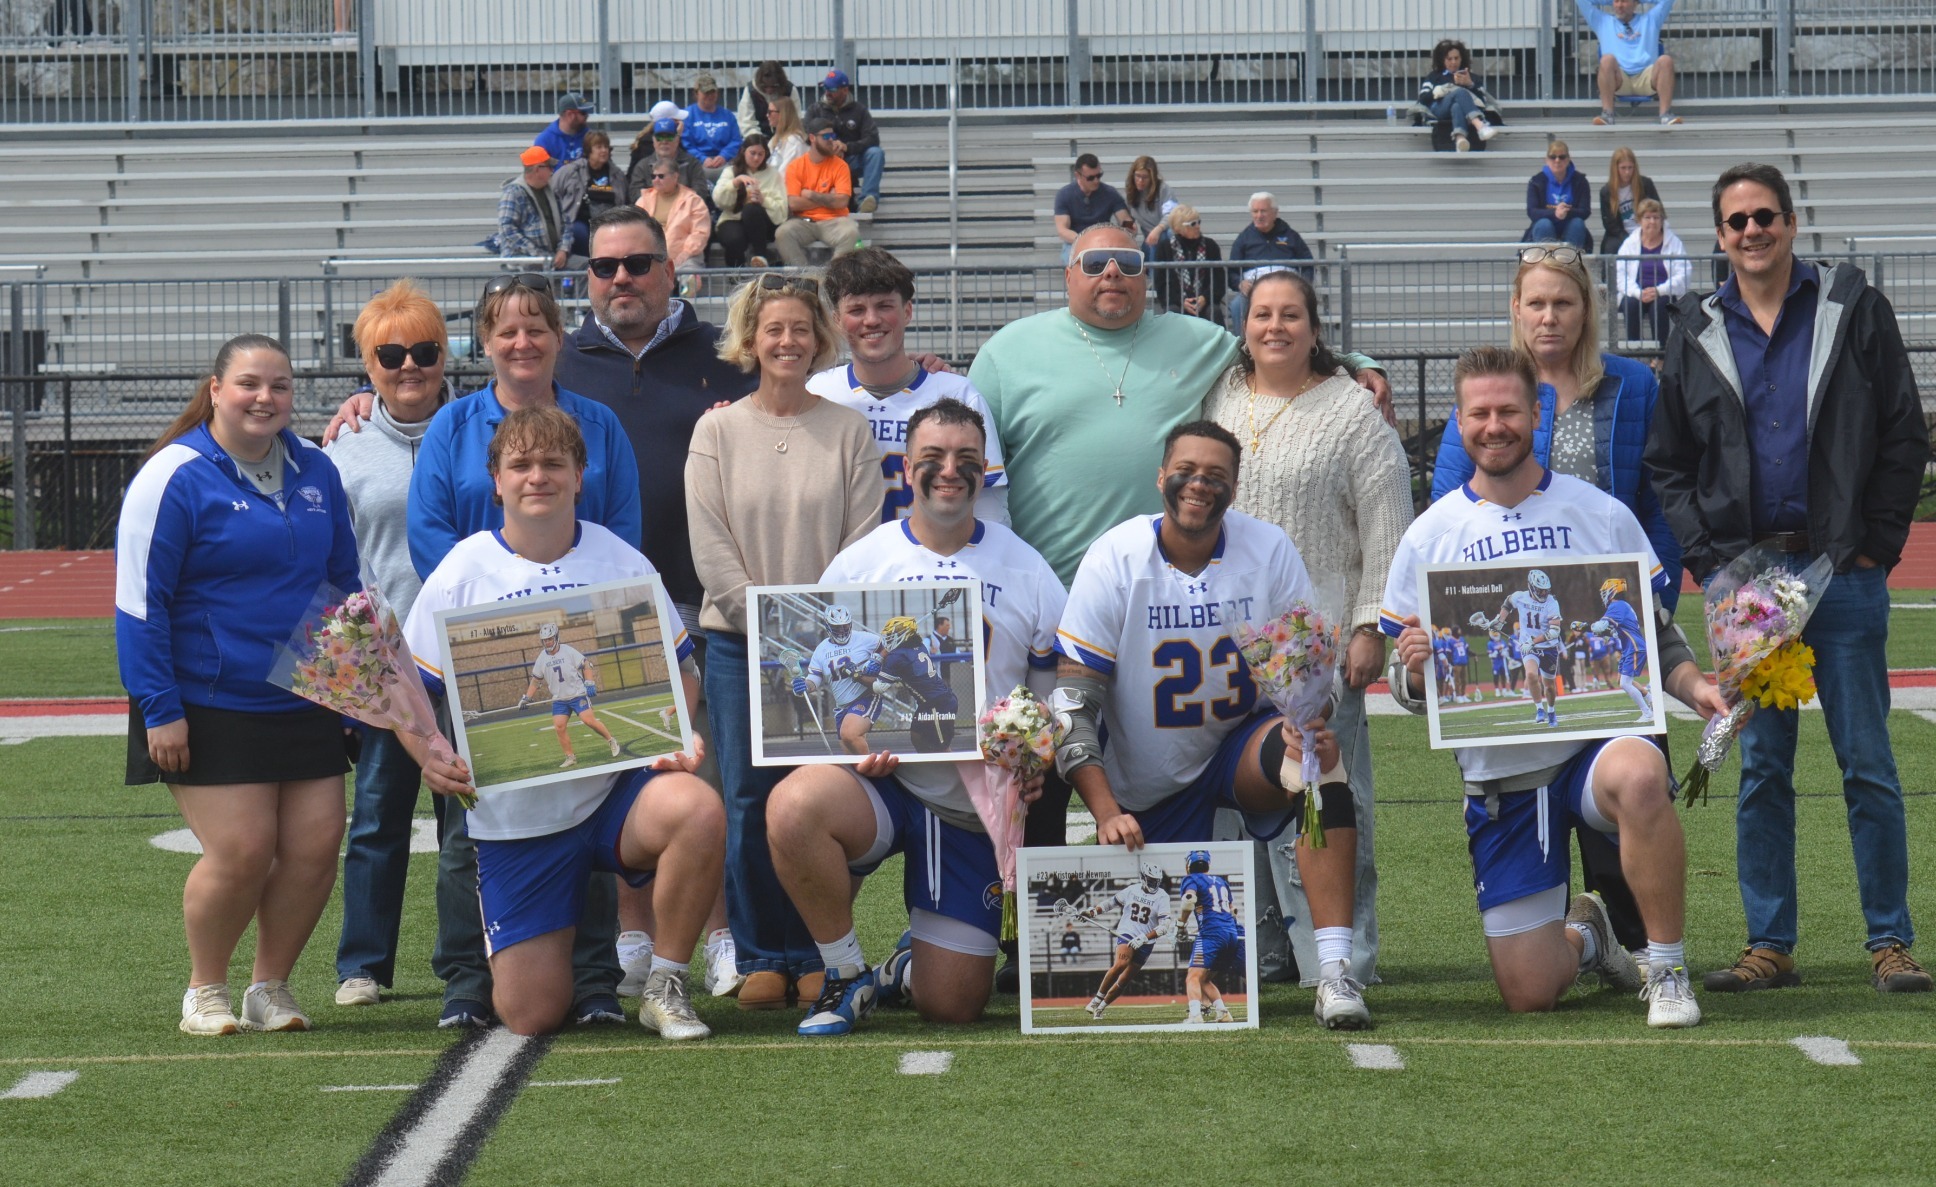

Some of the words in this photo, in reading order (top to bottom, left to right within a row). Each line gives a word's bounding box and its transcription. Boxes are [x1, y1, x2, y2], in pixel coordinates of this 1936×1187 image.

[1463, 526, 1571, 562] HILBERT
[1445, 586, 1456, 595] #11
[1461, 584, 1490, 594] Nathaniel
[1491, 583, 1503, 593] Dell
[1526, 612, 1541, 630] 11
[470, 629, 477, 638] #7
[553, 665, 565, 683] 7
[1152, 635, 1258, 729] 23
[917, 712, 935, 722] Aidan
[935, 711, 956, 721] Franko
[1036, 871, 1048, 880] #23
[1085, 869, 1111, 878] Newman
[1130, 902, 1152, 925] 23
